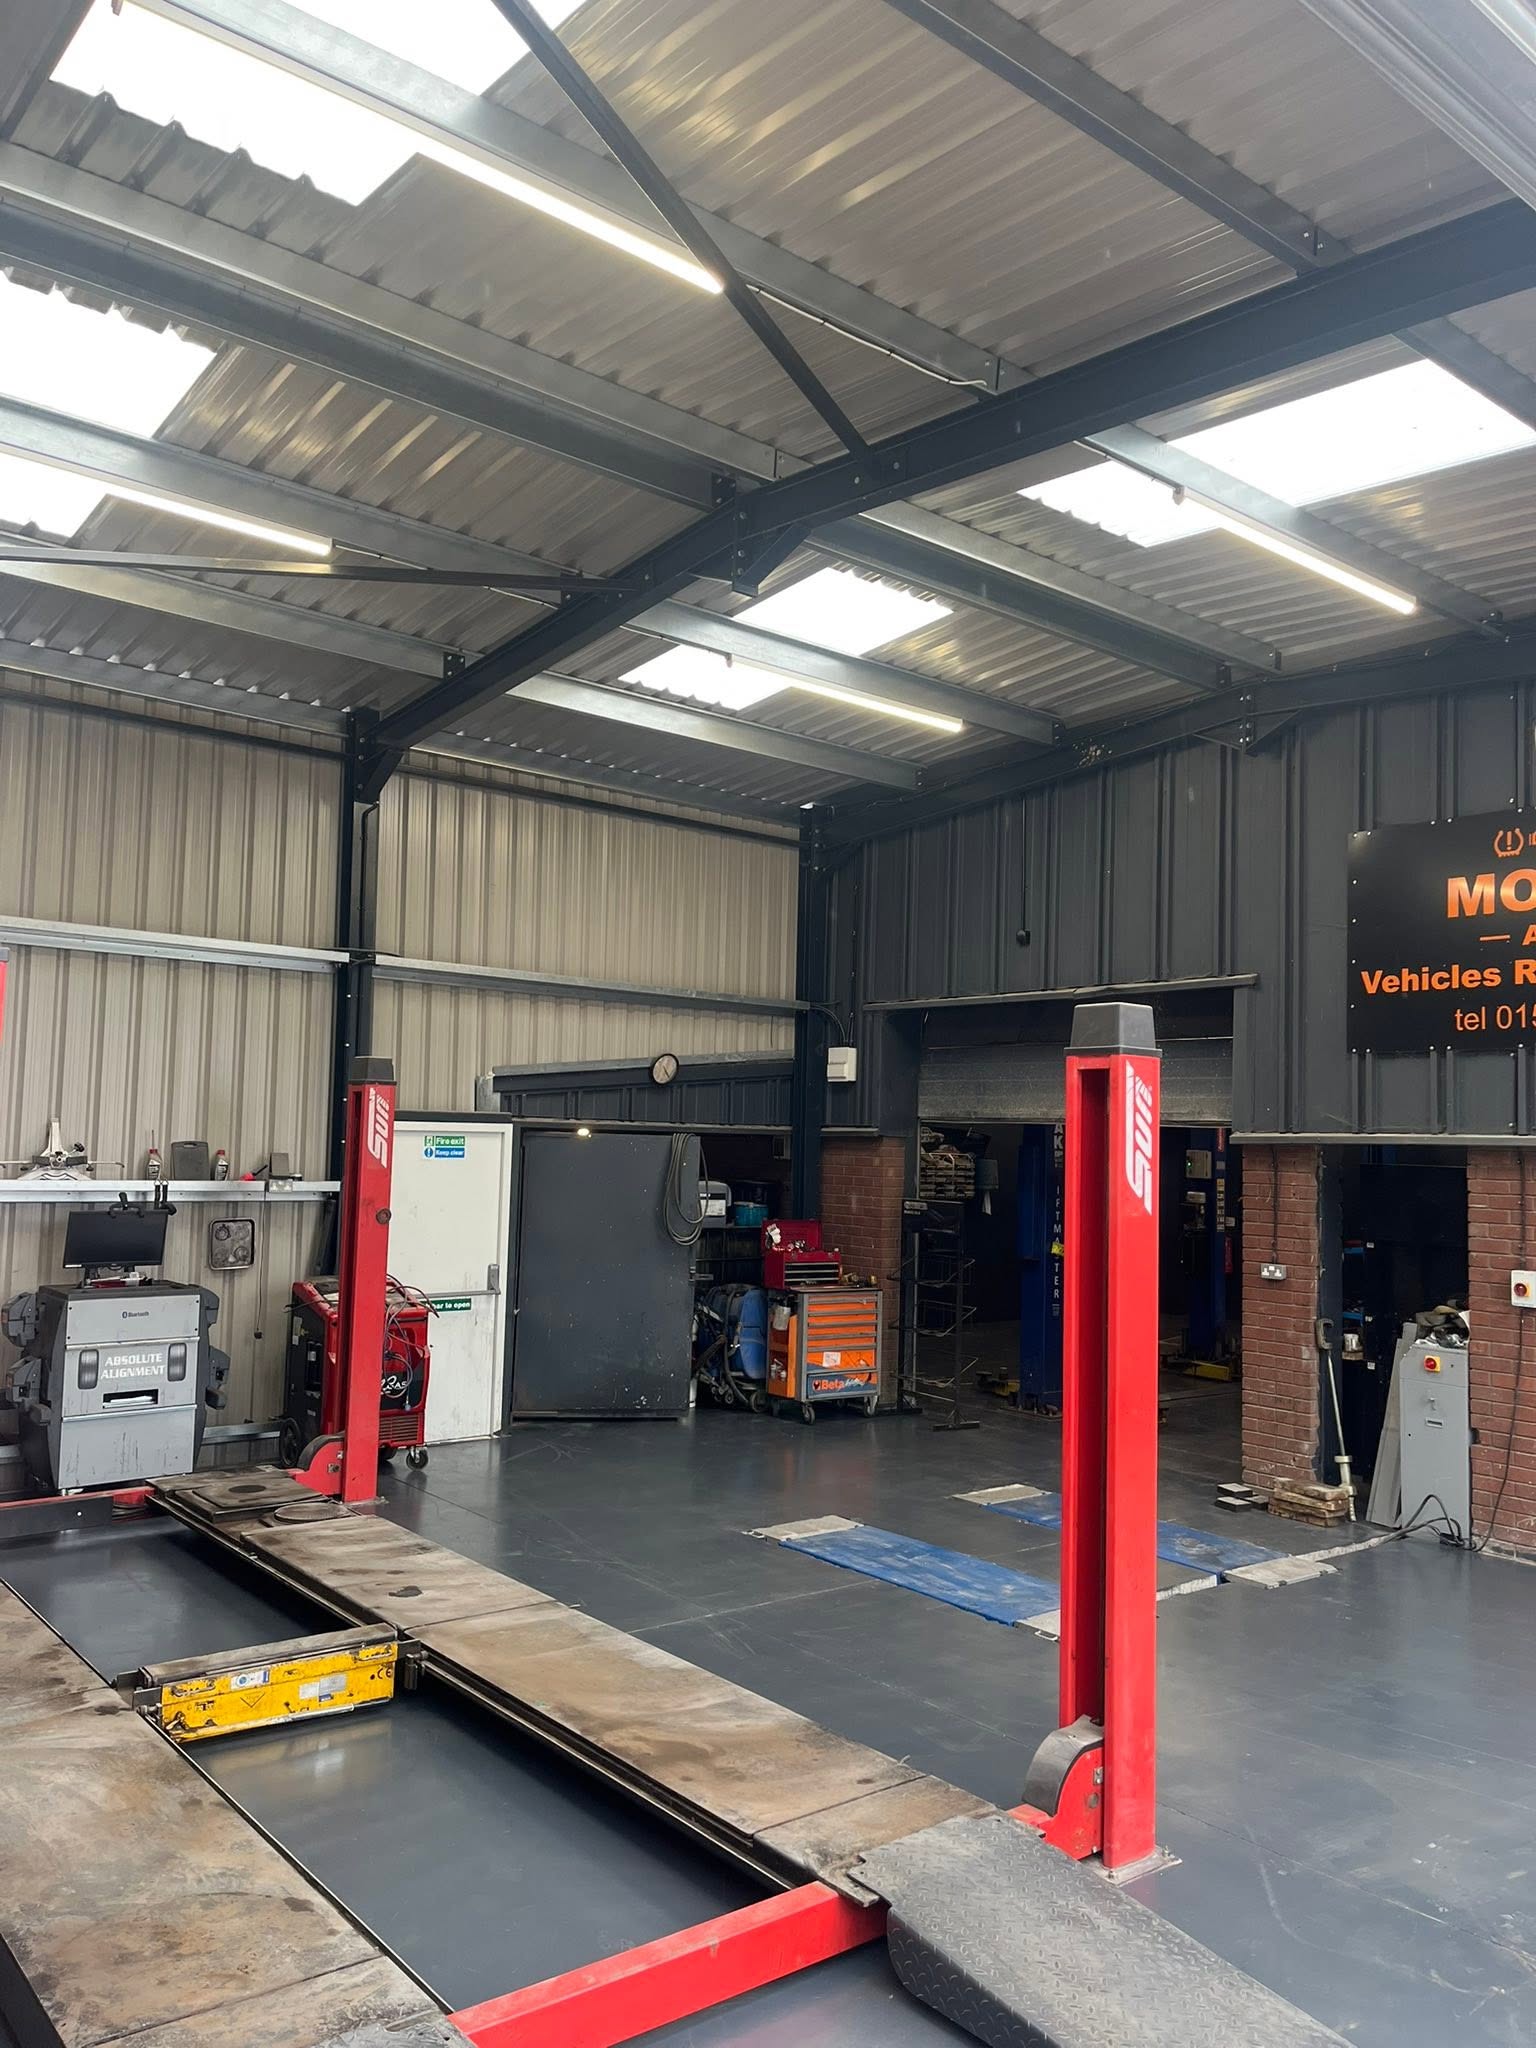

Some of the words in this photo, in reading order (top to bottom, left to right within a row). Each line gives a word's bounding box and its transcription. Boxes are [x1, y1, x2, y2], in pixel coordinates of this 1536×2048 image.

[1361, 964, 1501, 994] Vehicles
[1455, 1006, 1486, 1031] tel
[1496, 1002, 1536, 1030] 01
[436, 1137, 449, 1145] Fire
[451, 1137, 464, 1145] exit
[454, 1301, 470, 1309] open
[104, 1353, 162, 1367] ABSOLUTE
[100, 1365, 165, 1379] ALIGNMENT
[821, 1379, 845, 1390] Beta
